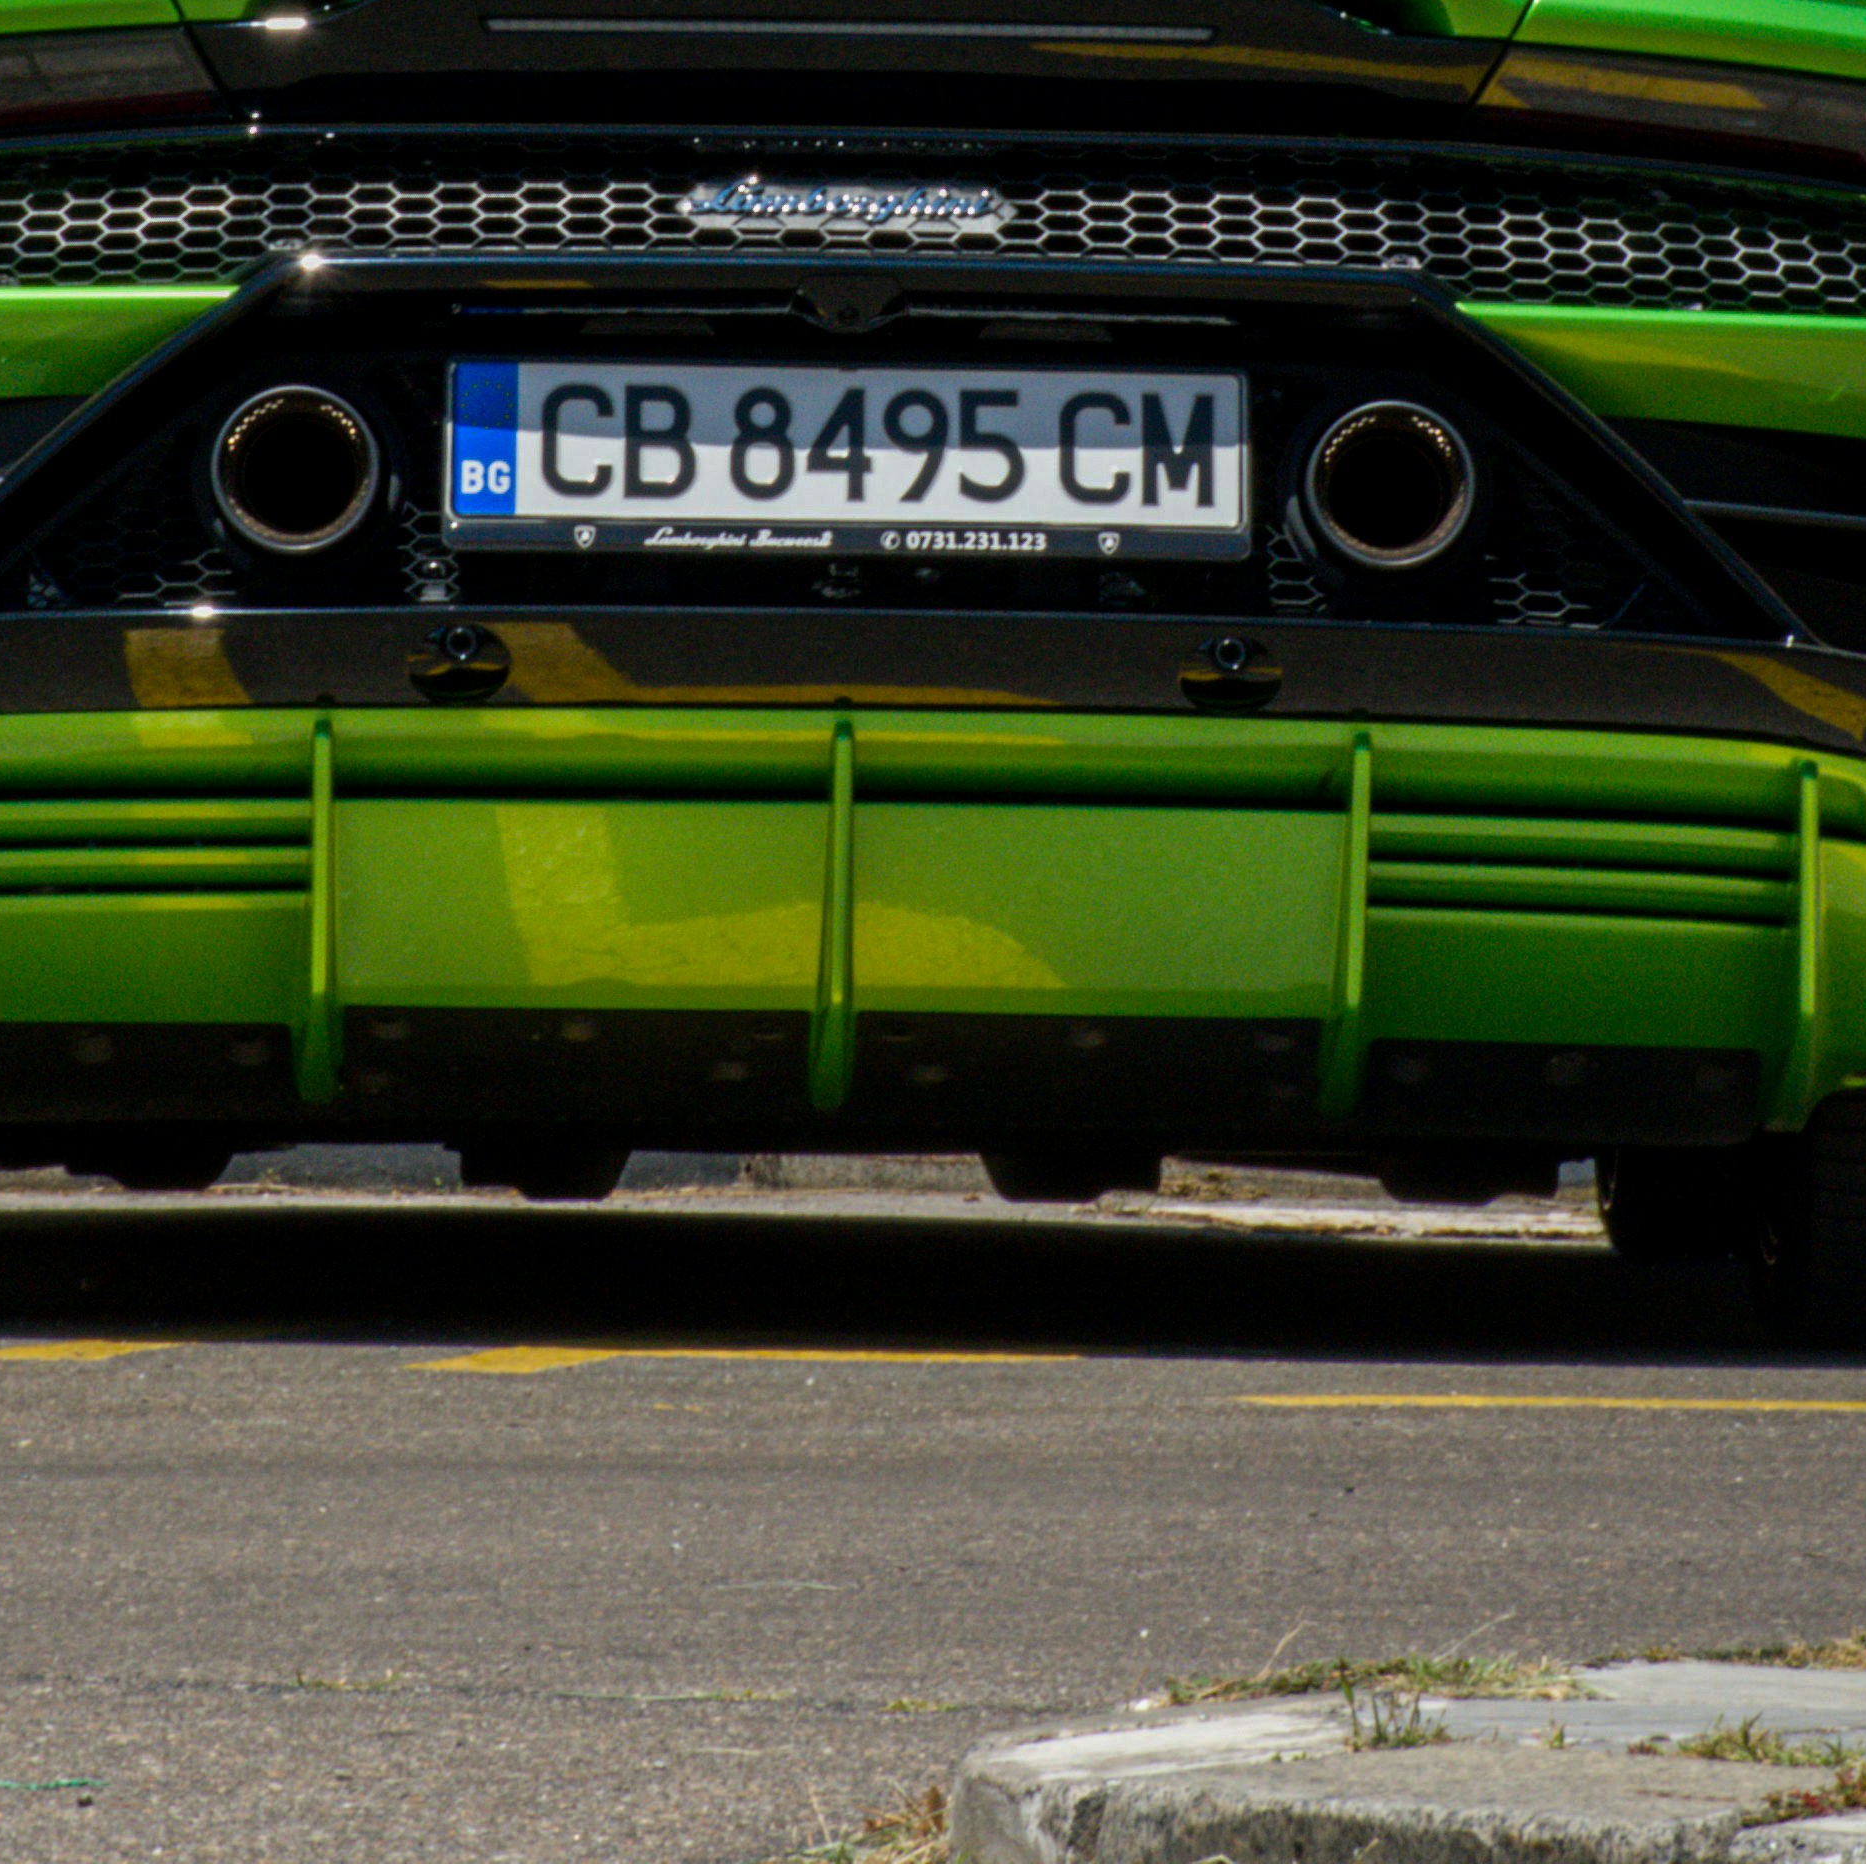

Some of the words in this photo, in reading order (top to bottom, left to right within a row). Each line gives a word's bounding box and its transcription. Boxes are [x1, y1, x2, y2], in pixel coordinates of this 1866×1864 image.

[679, 176, 997, 224] Lamborghini
[541, 383, 698, 499] CB
[731, 386, 1027, 503] 8495
[1058, 391, 1215, 508] CM
[460, 460, 511, 495] BG
[644, 526, 747, 550] Lamborghini
[905, 530, 1047, 551] 0731.231.123
